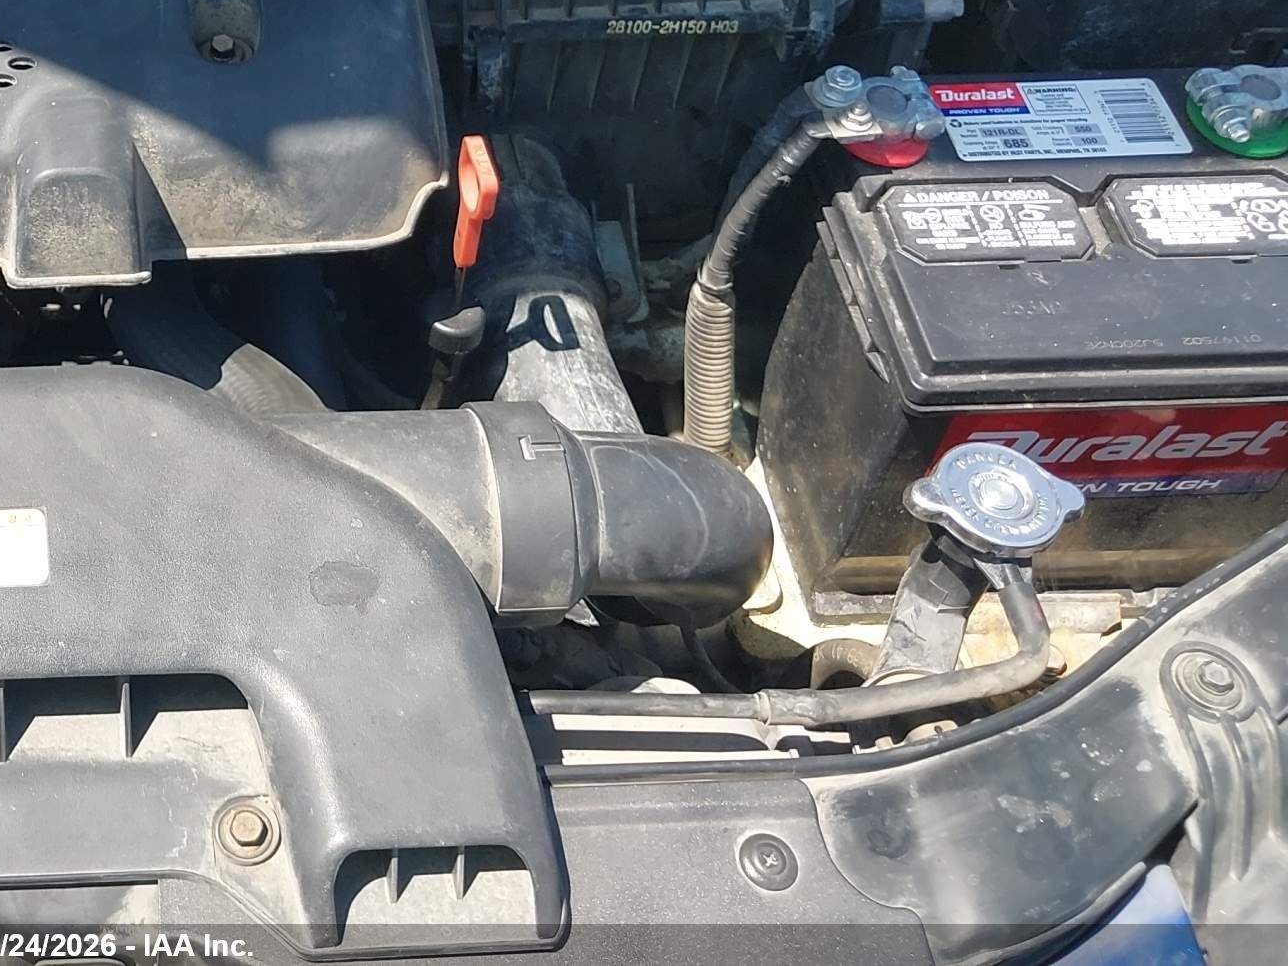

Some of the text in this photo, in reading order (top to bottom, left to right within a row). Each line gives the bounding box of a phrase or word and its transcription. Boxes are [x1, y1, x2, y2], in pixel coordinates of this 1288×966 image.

[606, 20, 739, 34] 28100-2H150 H03
[935, 88, 1015, 103] Duralast
[948, 108, 988, 116] PROVEN
[1003, 138, 1029, 149] 685
[916, 191, 980, 203] DANGER
[992, 190, 1049, 201] POISON
[1117, 478, 1222, 493] TOUGH
